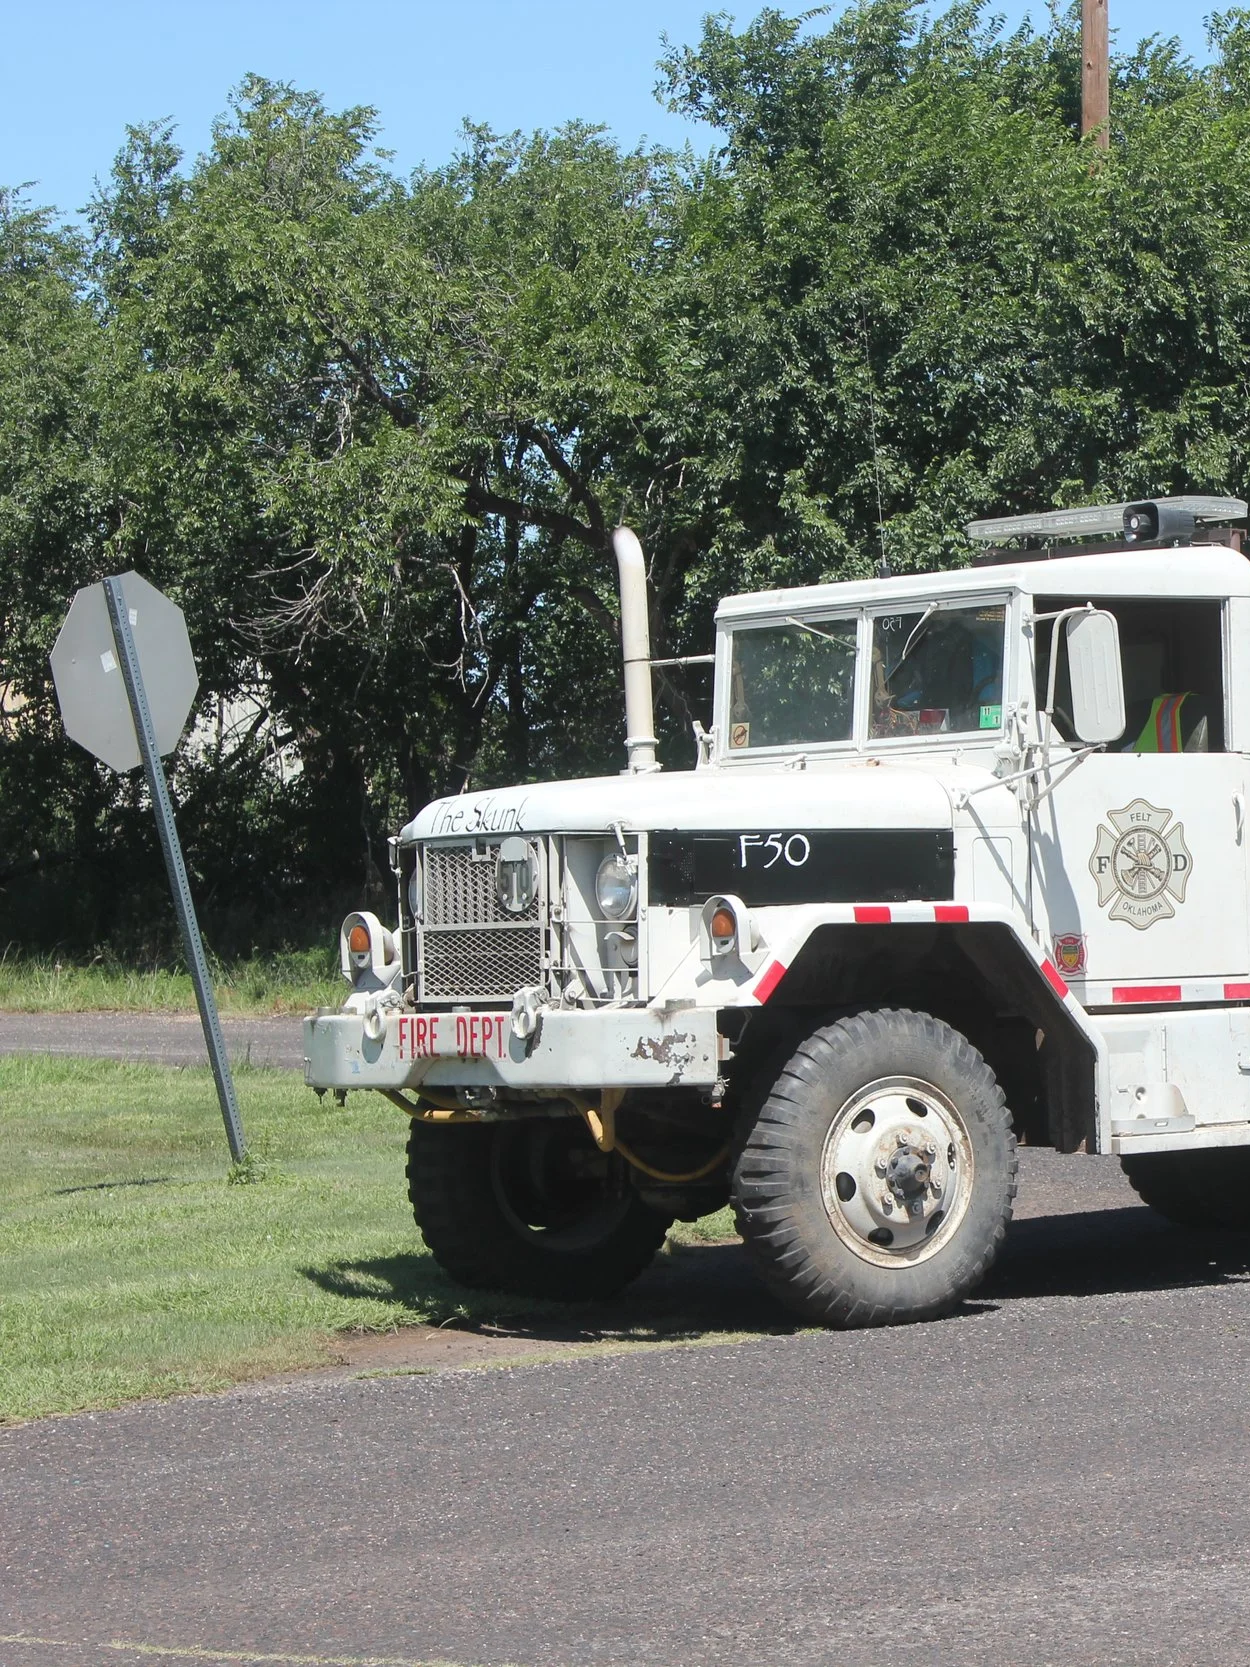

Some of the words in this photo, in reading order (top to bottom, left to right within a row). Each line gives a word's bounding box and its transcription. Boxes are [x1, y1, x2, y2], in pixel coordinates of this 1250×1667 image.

[430, 799, 464, 834] The
[465, 796, 530, 833] Skunk
[1130, 812, 1152, 823] FELT
[739, 833, 810, 869] F50
[1096, 856, 1110, 874] F
[1172, 854, 1188, 872] D
[1122, 901, 1164, 916] OKLAHOMA
[399, 1017, 440, 1059] FIRE
[456, 1016, 507, 1058] DEPT.
